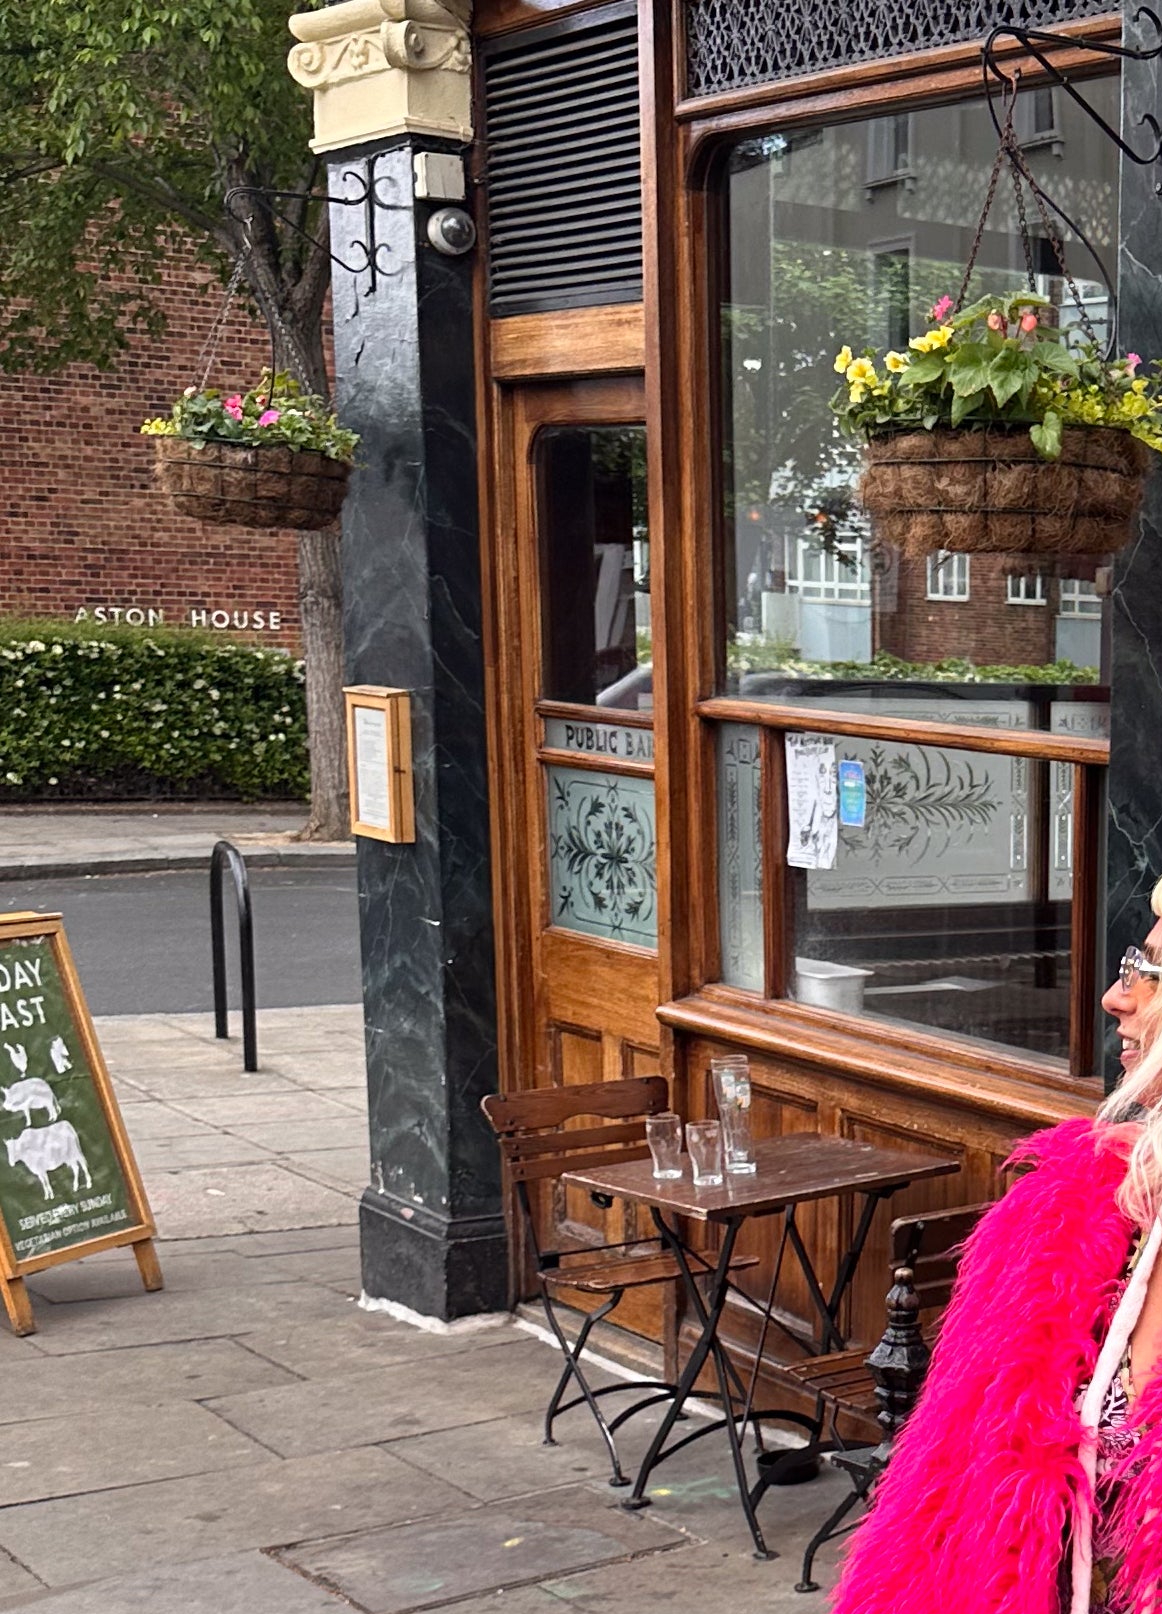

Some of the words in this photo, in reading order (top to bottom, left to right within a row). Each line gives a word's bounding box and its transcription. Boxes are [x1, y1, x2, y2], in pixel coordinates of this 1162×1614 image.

[74, 607, 163, 627] ASTON
[192, 610, 281, 630] HOUSE
[565, 725, 617, 753] PUBLIC
[1, 996, 46, 1031] AST
